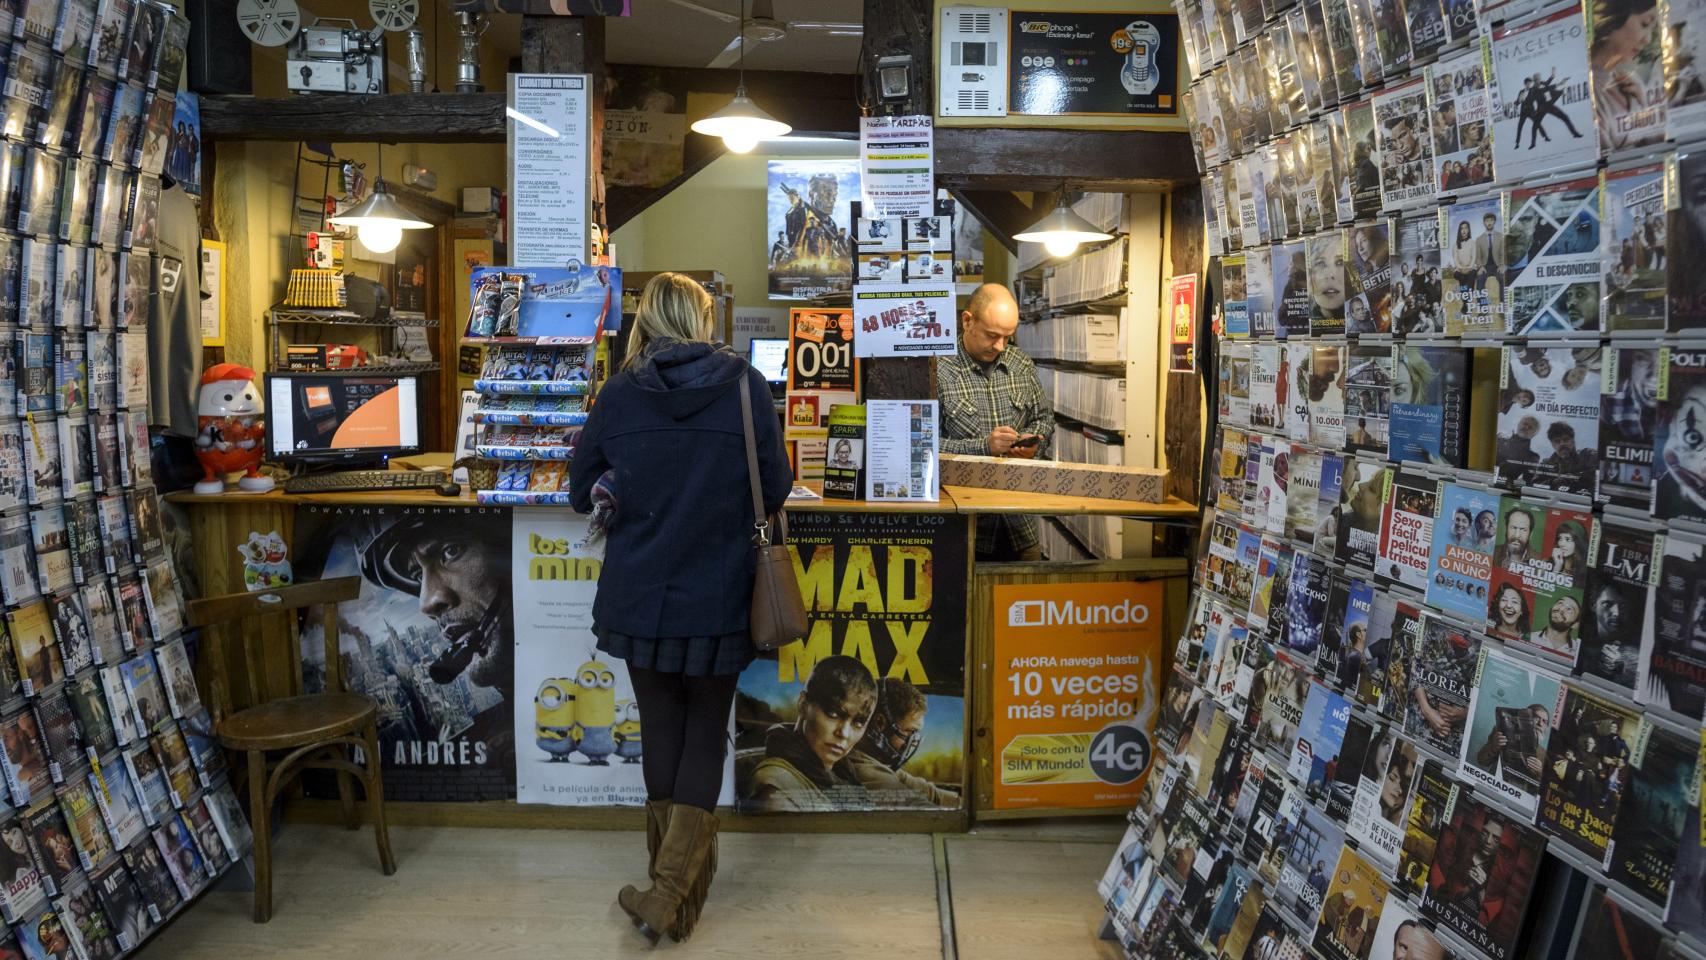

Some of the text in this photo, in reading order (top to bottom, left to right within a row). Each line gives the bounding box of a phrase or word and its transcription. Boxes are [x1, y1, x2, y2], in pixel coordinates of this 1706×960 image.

[1050, 24, 1073, 33] phone
[1498, 25, 1582, 60] NACLETO
[892, 119, 931, 127] TARIFAS
[1386, 187, 1430, 202] TENGO GANAS
[861, 315, 880, 334] 48
[1462, 313, 1494, 326] Tren
[1175, 323, 1189, 337] Kiala
[1535, 401, 1599, 416] UN DÍA PERFECTO
[793, 414, 813, 423] Kiala
[1315, 415, 1342, 426] 10.000
[833, 425, 857, 434] SPARK
[310, 506, 385, 515] DWAYNE
[788, 514, 945, 526] MUNDO SE VUELVE LOCO
[1393, 511, 1423, 530] Sexo
[1391, 523, 1419, 544] fácil,
[528, 531, 570, 555] los
[1388, 549, 1427, 571] tristes
[1440, 557, 1449, 568] O
[1447, 547, 1492, 567] AHORA
[1529, 557, 1552, 571] OCHO
[787, 545, 933, 613] MAD
[1508, 561, 1573, 588] APELLIDOS
[1522, 576, 1556, 593] VASCOS
[1014, 599, 1149, 625] SIM Mundo
[778, 620, 931, 685] MAX
[1060, 656, 1104, 669] navega
[1106, 654, 1139, 665] hasta
[1008, 671, 1138, 696] 10 veces
[1007, 697, 1139, 721] más rápido!
[394, 735, 487, 765] ANDRÉS
[1020, 745, 1085, 758] ¡Solo con tu
[1091, 732, 1143, 771] 4G
[1007, 759, 1085, 771] SIM Mundo!
[1165, 775, 1174, 786] YO
[1462, 763, 1523, 800] NEGOCIADOR
[543, 783, 555, 792] La
[558, 783, 600, 796] película
[602, 783, 616, 793] de
[1161, 783, 1170, 795] TA
[575, 795, 589, 803] ya
[607, 794, 646, 804] Blu-ray
[1563, 802, 1582, 819] que
[1559, 814, 1575, 828] las
[1374, 834, 1383, 847] LA
[1379, 825, 1387, 836] TU
[1386, 827, 1402, 849] VEN
[1280, 867, 1291, 884] 5
[1425, 896, 1505, 959] MUSARAÑAS
